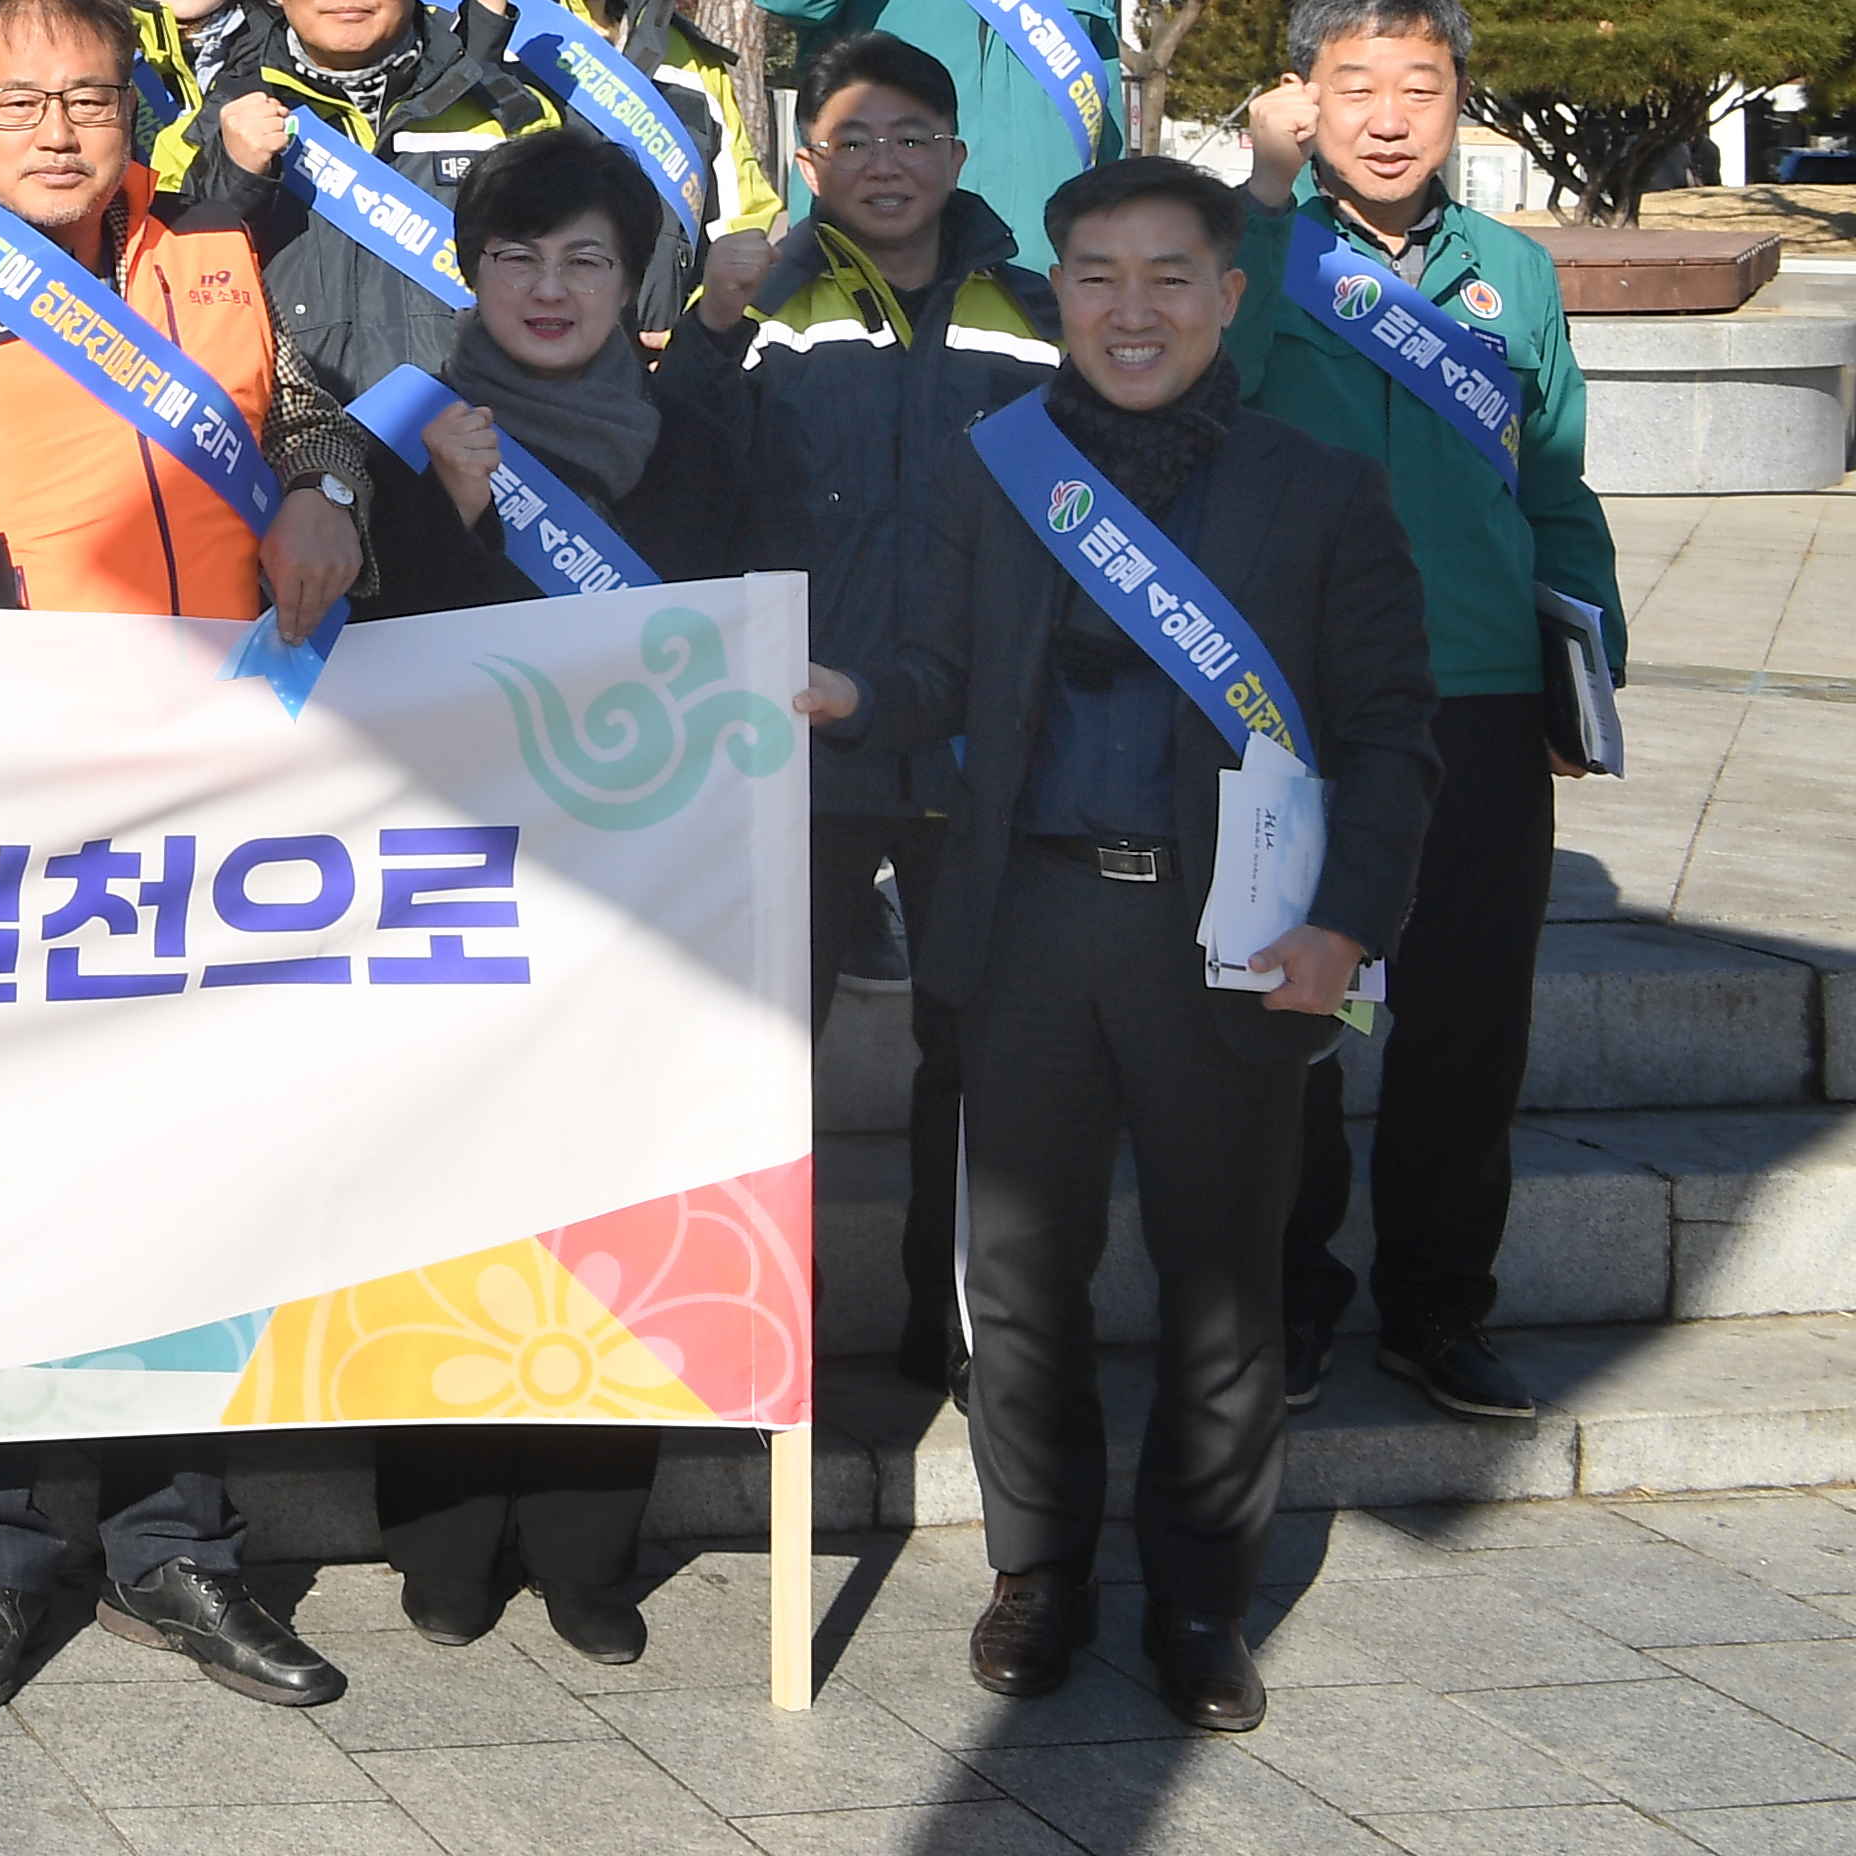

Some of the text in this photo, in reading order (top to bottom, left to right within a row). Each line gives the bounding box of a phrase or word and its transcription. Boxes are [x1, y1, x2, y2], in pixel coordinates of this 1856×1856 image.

[1020, 3, 1081, 79] 4일은
[296, 139, 437, 255] 매월 4일은
[30, 280, 196, 427] 안전신문고로
[192, 407, 241, 473] 신고
[1373, 306, 1512, 432] 매월 4일은
[1079, 518, 1238, 679] 매월 4일은
